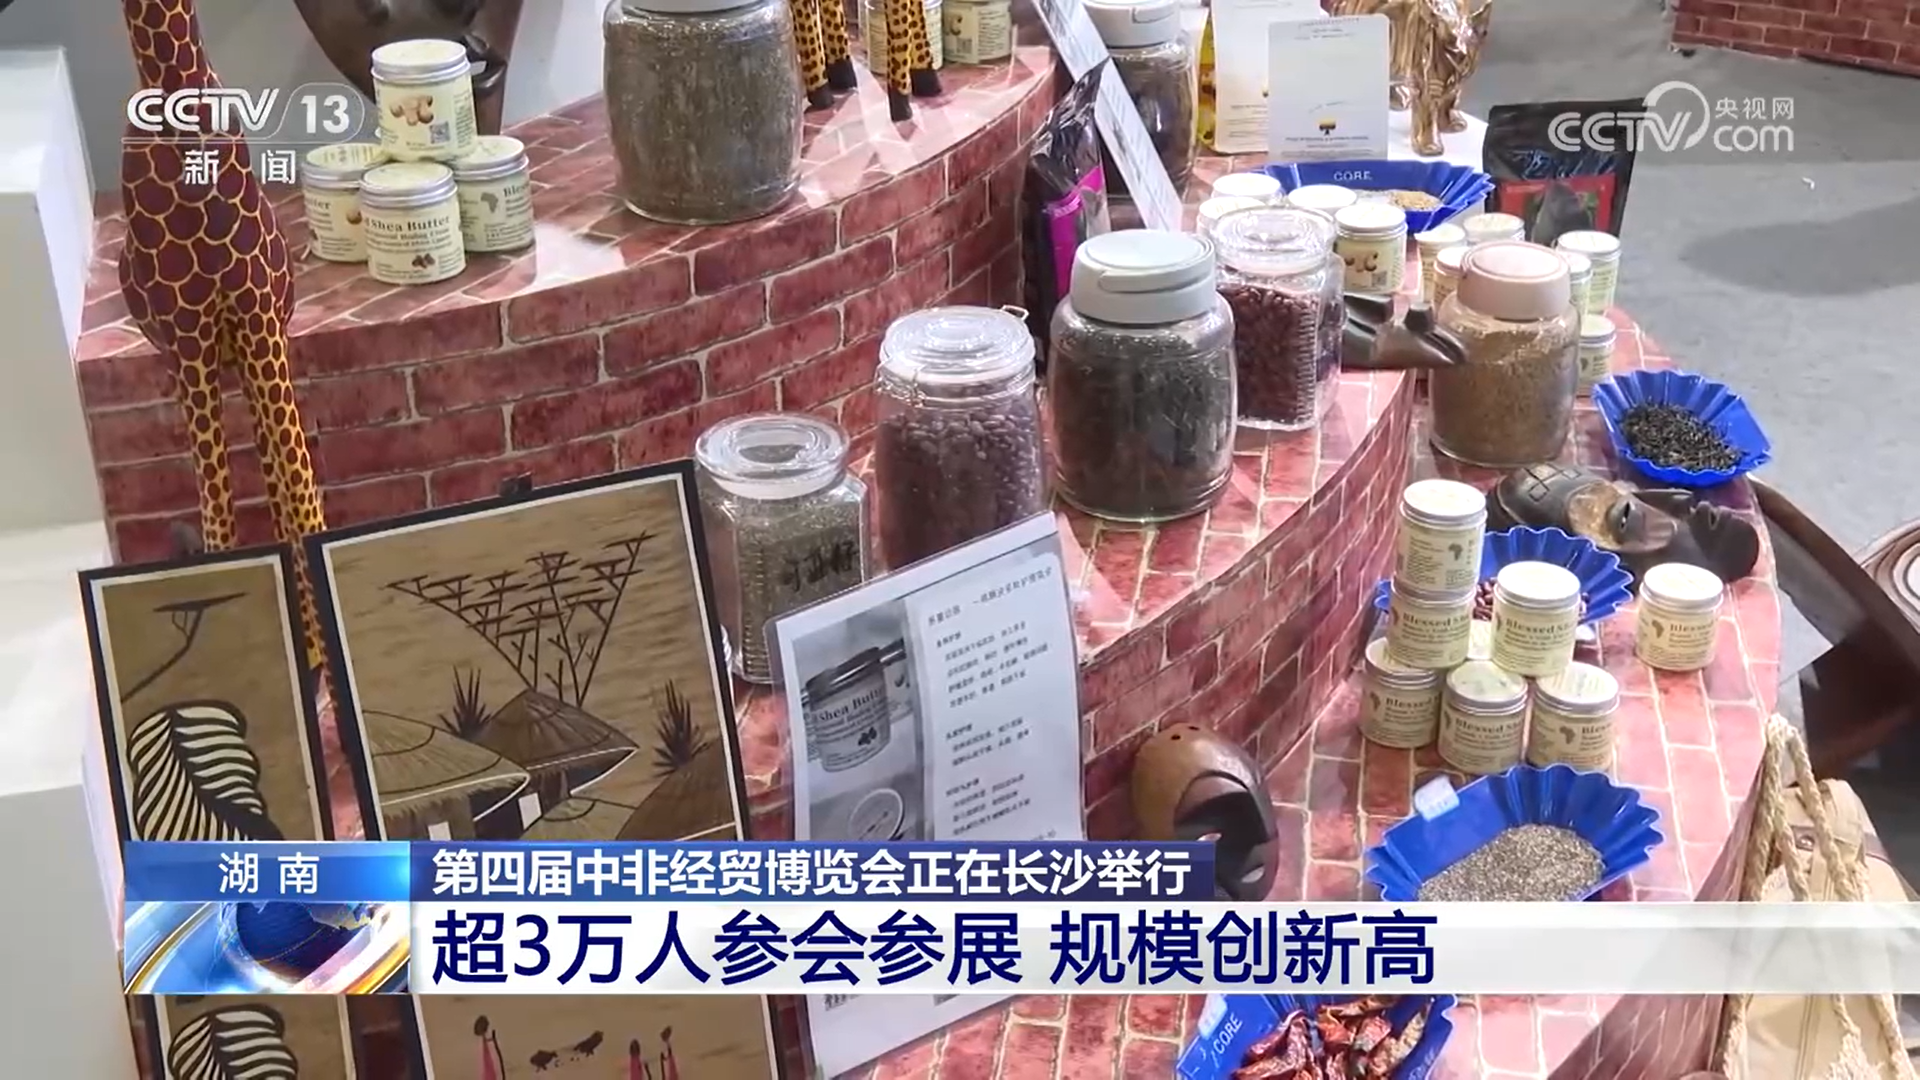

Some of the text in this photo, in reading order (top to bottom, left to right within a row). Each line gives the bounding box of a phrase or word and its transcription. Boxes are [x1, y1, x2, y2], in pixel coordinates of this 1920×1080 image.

[1333, 170, 1373, 181] CORE
[407, 215, 450, 232] Butter
[1505, 617, 1555, 634] Blessed
[1213, 1012, 1243, 1055] CORE
